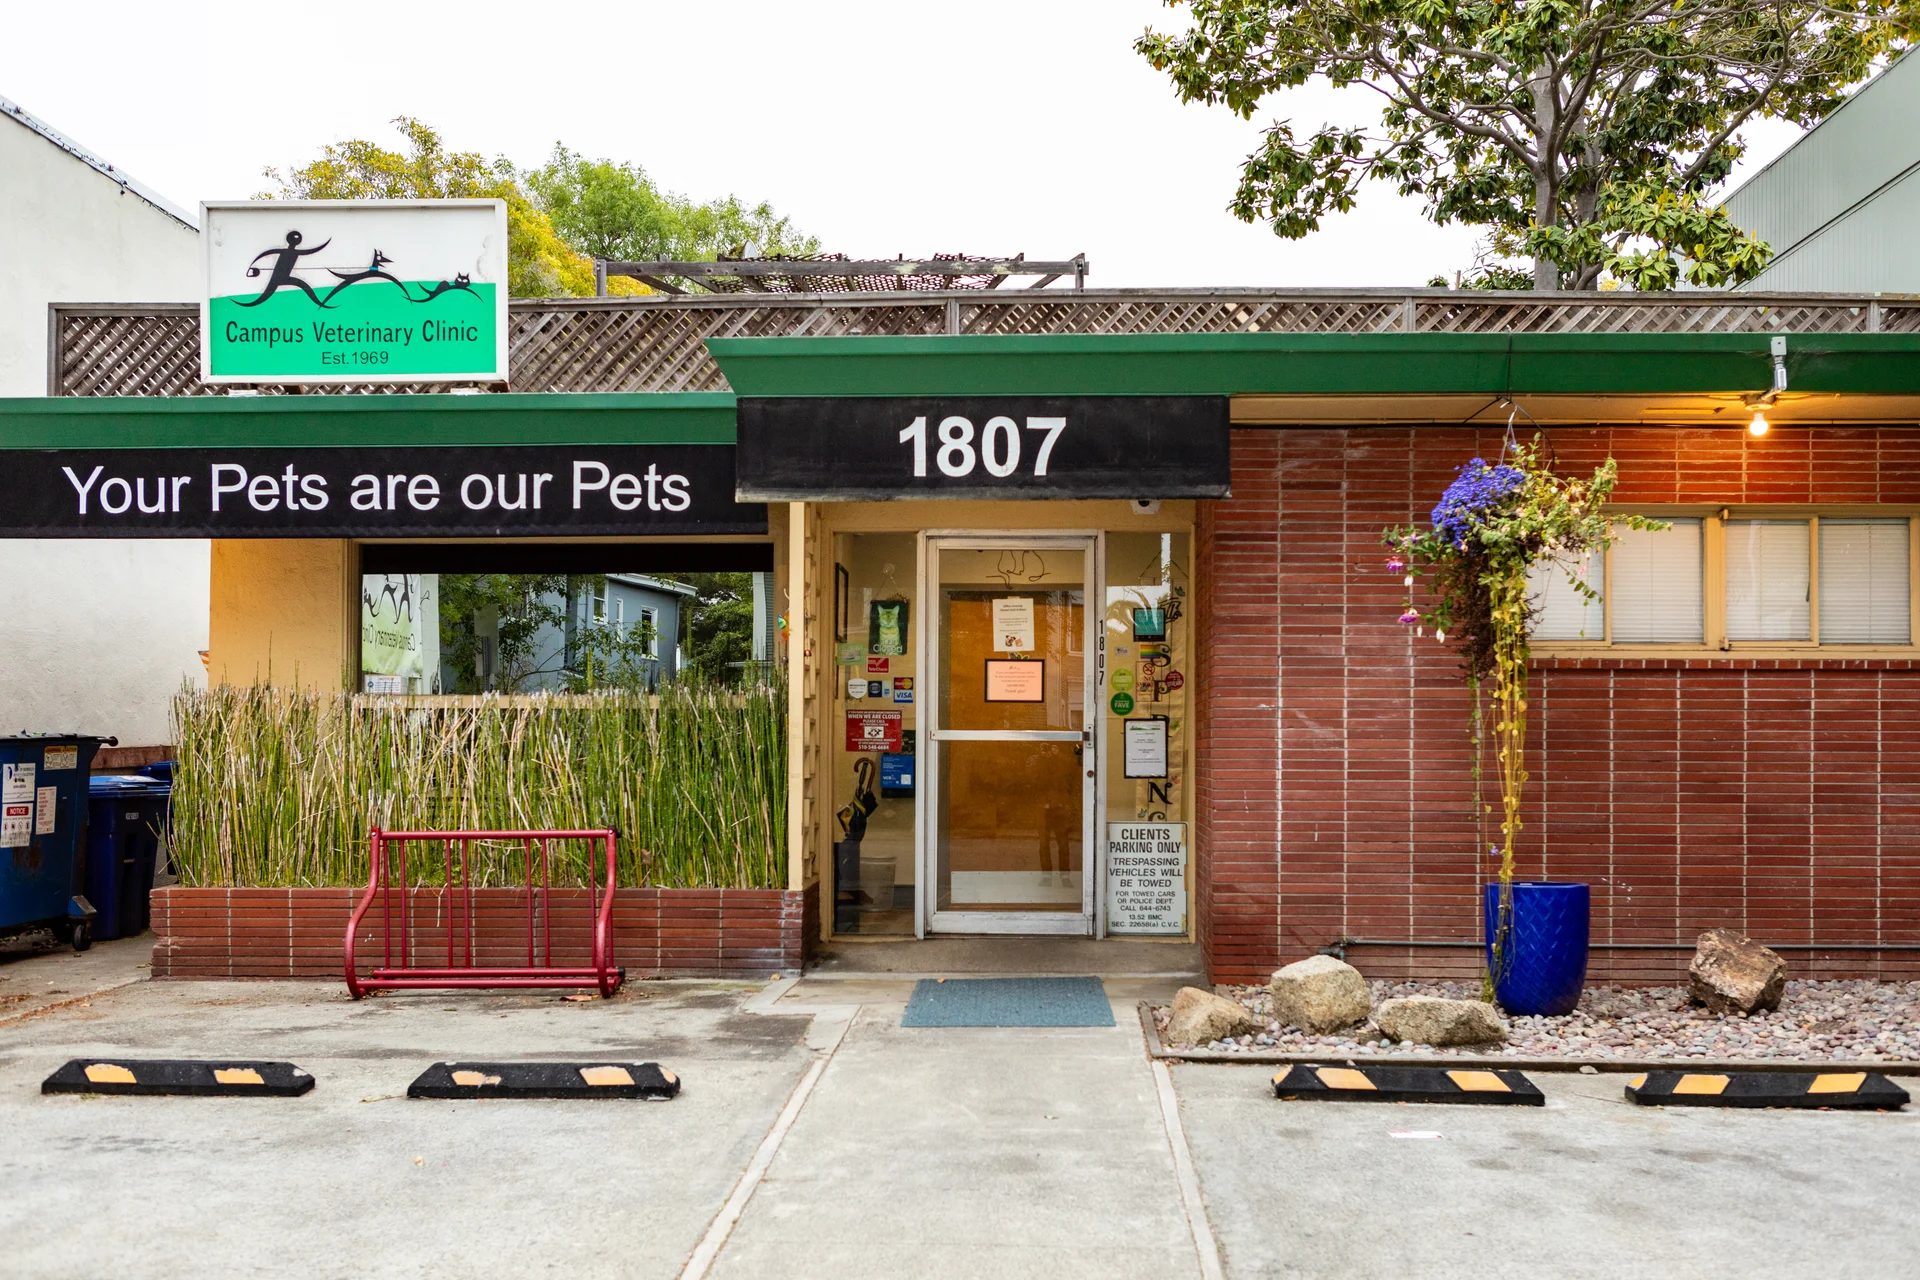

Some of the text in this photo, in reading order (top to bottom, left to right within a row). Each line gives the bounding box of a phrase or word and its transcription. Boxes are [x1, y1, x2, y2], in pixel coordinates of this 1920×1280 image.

[225, 319, 478, 348] Campus Veterinary Clinic
[321, 350, 389, 366] Est.1969
[899, 415, 1067, 477] 1807
[62, 460, 691, 514] Your Pets are our Pets
[872, 643, 903, 653] Closed
[896, 691, 913, 699] VISA
[1114, 701, 1130, 709] FAVE
[1121, 828, 1170, 840] CLIENTS
[1109, 841, 1181, 853] PARKING ONLY
[1113, 857, 1180, 866] TRESPASSING
[1109, 868, 1183, 877] VEHICLES WILL
[1120, 879, 1172, 888] BE TOWED
